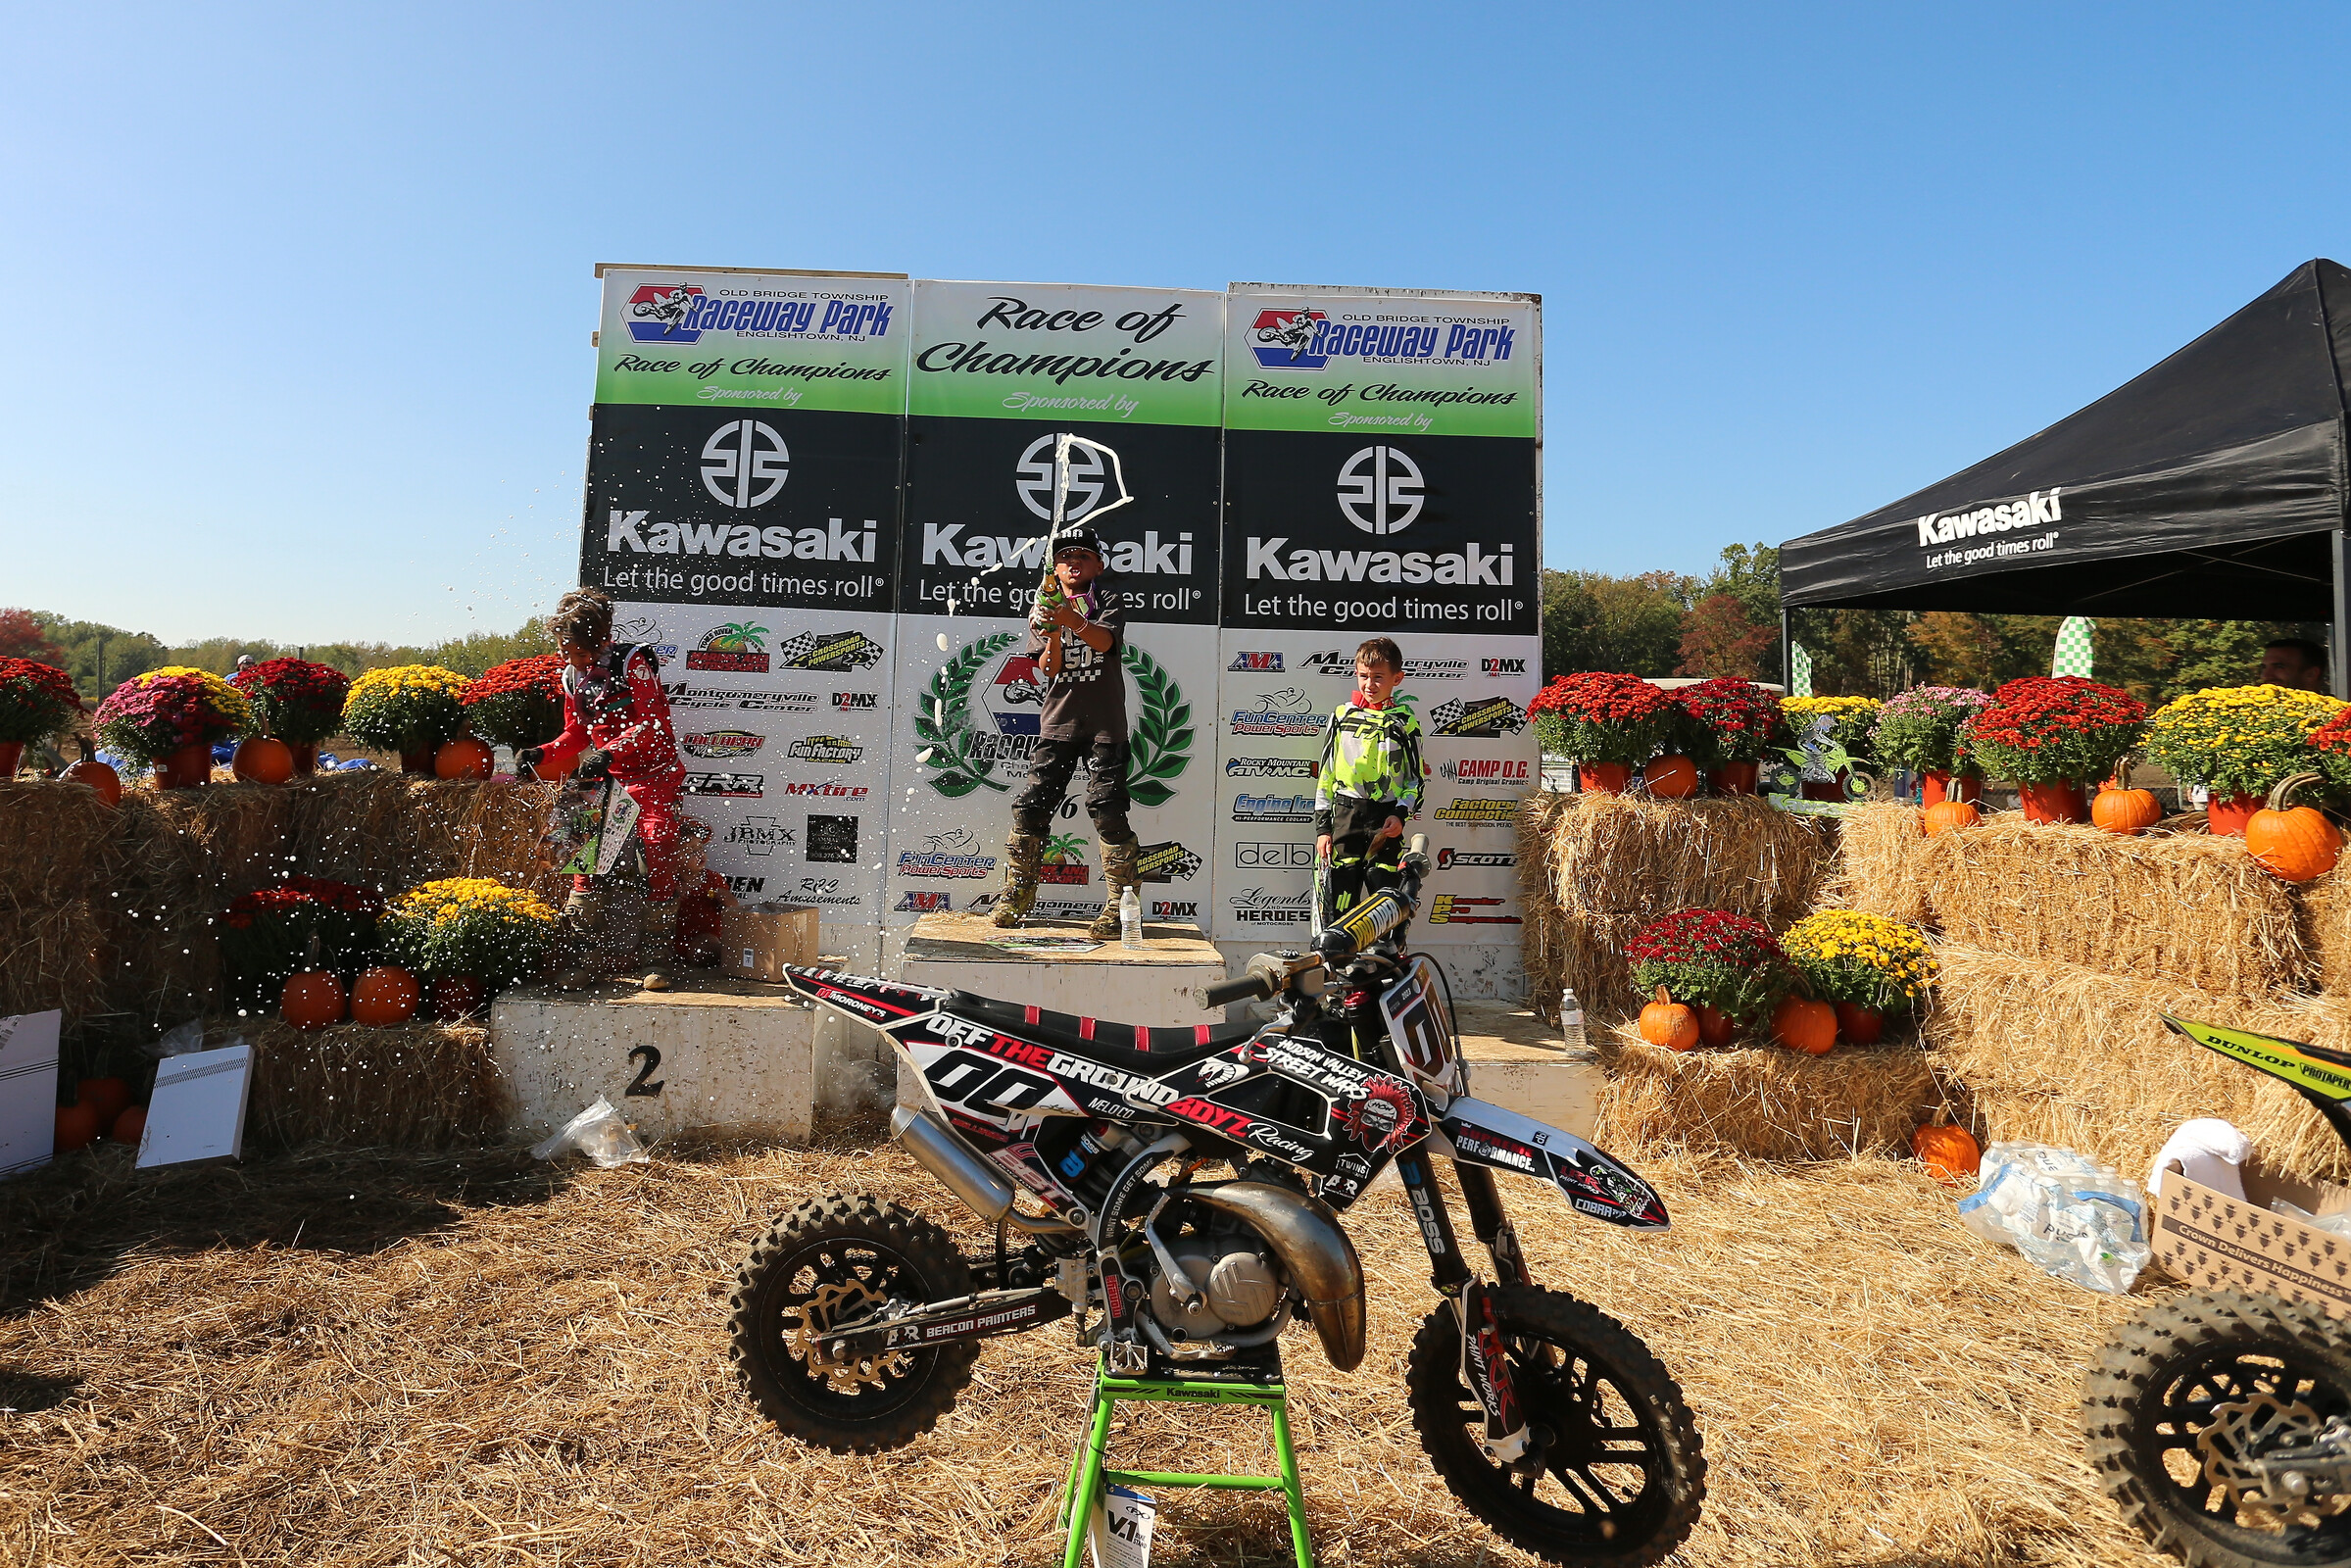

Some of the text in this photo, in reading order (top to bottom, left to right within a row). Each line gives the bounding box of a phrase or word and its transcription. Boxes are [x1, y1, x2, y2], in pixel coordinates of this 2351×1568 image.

[811, 292, 889, 301] TOWNSHIP
[681, 295, 894, 336] Raceway Park
[975, 296, 1188, 343] Race of
[1342, 314, 1510, 325] OLD BRIDGE TOWNSHIP
[1308, 319, 1516, 361] Raceway Park
[613, 353, 892, 382] Race of Champions
[916, 341, 1215, 386] Champions
[697, 385, 803, 406] Sponsored by
[1002, 392, 1140, 418] Sponsored by
[1242, 379, 1519, 409] Race of Champions
[1328, 412, 1433, 432] Sponsored by
[1918, 487, 2063, 548] Kawasaki
[607, 510, 877, 564] Kawasaki
[922, 522, 1193, 575] Kawaki
[1247, 536, 1514, 586] Kawasaki
[1926, 554, 1942, 569] Let
[1944, 551, 1963, 565] the
[1964, 542, 1994, 565] good
[1996, 539, 2030, 558] times
[604, 565, 642, 588] Let
[645, 566, 683, 590] the
[690, 569, 755, 596] good
[761, 572, 827, 596] times
[919, 578, 955, 602] Let
[961, 579, 1003, 604] the
[1245, 593, 1281, 615] Let
[1287, 594, 1328, 616] the
[1334, 596, 1396, 623] good
[1403, 599, 1469, 620] times
[808, 640, 866, 666] POWERSPORTS
[812, 634, 860, 658] CROSSROAD
[1228, 651, 1285, 670] AMA
[1481, 658, 1526, 673] D2MX
[668, 696, 817, 712] Cycle Center
[832, 692, 878, 708] D2MX
[1461, 700, 1507, 724] CROSSROAD
[1234, 723, 1320, 736] PowerSports
[1457, 705, 1513, 733] POWERSPORTS
[1240, 758, 1311, 767] ROCKY MOUNTAIN
[1458, 760, 1529, 778] CAMP O.G.
[1235, 794, 1315, 815] Engine Ice
[1450, 799, 1518, 810] Factory
[723, 825, 797, 843] JBMX
[1136, 845, 1179, 867] ROSSROAD
[1136, 850, 1185, 875] WERSPORTS
[1239, 843, 1311, 866] delb
[900, 864, 988, 878] PowerSports
[776, 890, 862, 905] Amusements
[895, 891, 952, 910] AMA
[1151, 901, 1199, 916] D2MX
[1229, 886, 1311, 910] Legends
[1236, 910, 1311, 922] HEROES
[829, 992, 887, 1017] MORONEY'S
[1278, 1040, 1369, 1083] HUDSON VALLEY
[2206, 1035, 2296, 1068] DUNLOP
[624, 1045, 665, 1097] 2
[1254, 1046, 1372, 1101] STREET WARS
[2303, 1064, 2351, 1091] PROTAPER
[1080, 1134, 1101, 1154] BOSS
[1248, 1122, 1315, 1162] Racing
[1341, 1158, 1366, 1174] TWINS
[1111, 1192, 1127, 1216] SOME
[1122, 1175, 1137, 1193] GET
[1135, 1157, 1154, 1178] SOME
[1411, 1187, 1446, 1254] BOSS
[1575, 1199, 1613, 1218] COBRA
[2179, 1224, 2217, 1249] Crown
[2218, 1241, 2271, 1269] Delivers
[926, 1304, 1036, 1338] BEACON PAINTERS
[1466, 1334, 1501, 1417] PAINT WORKS
[1166, 1387, 1221, 1399] Kawasaki
